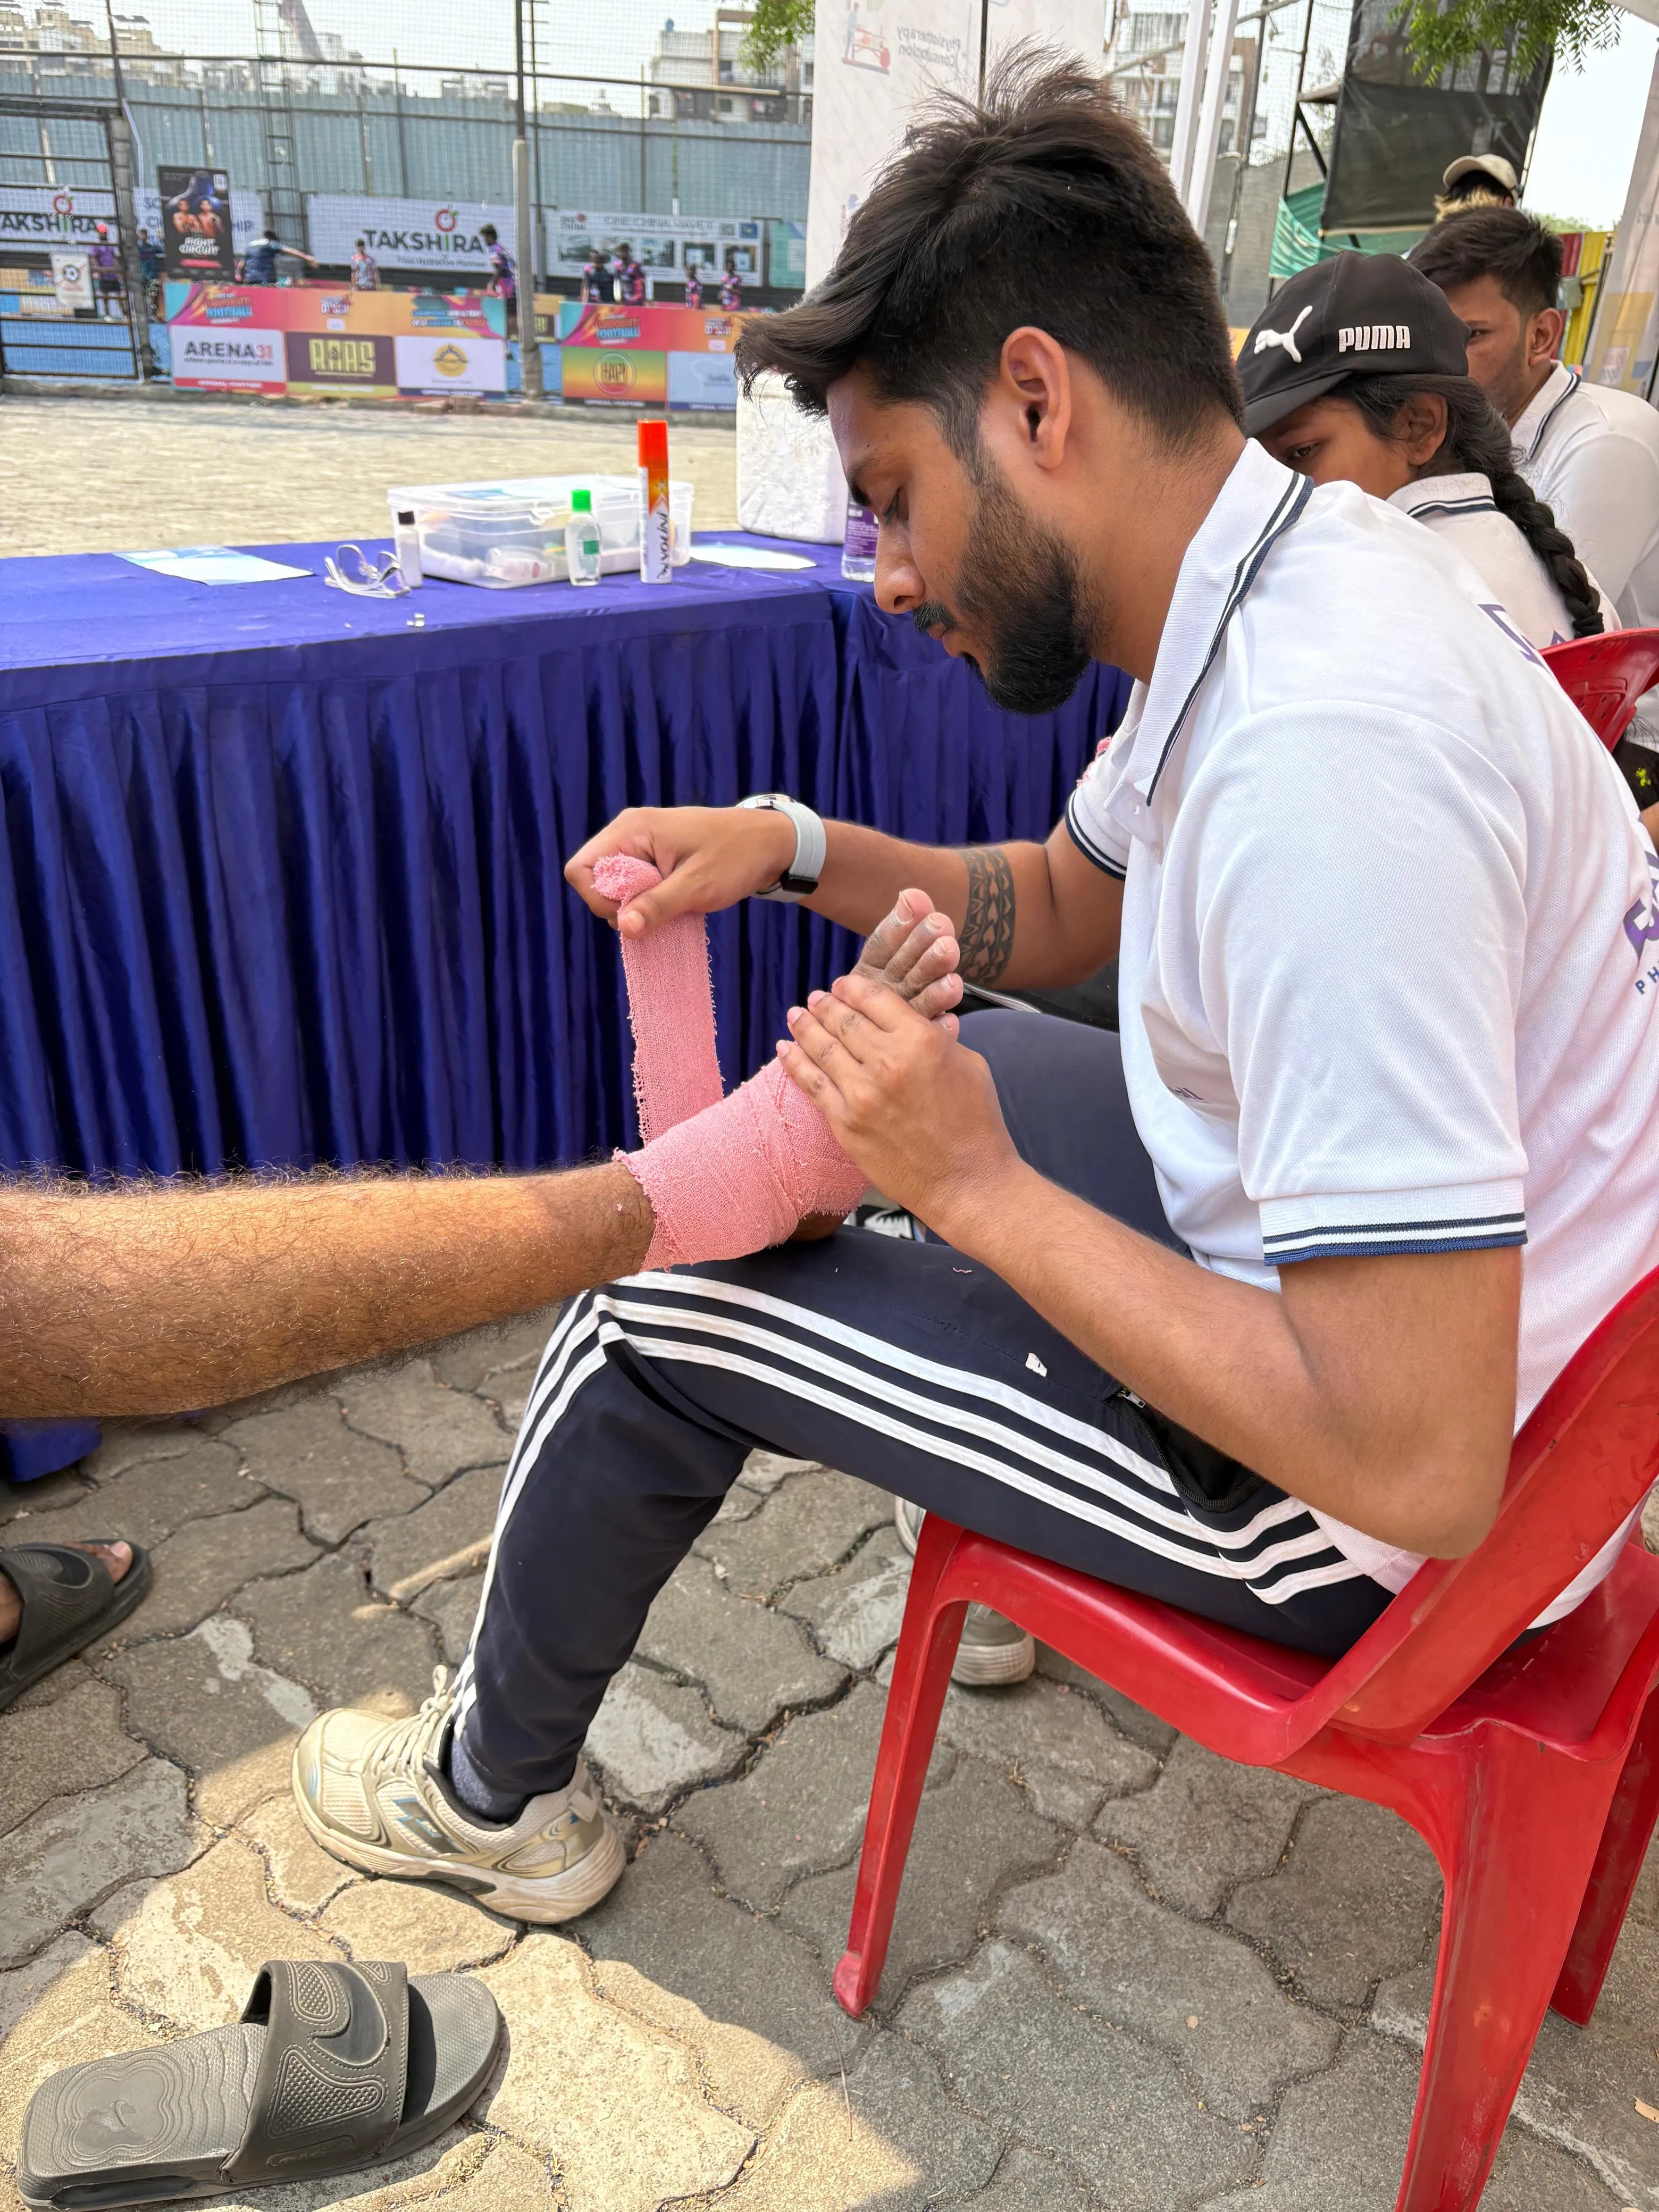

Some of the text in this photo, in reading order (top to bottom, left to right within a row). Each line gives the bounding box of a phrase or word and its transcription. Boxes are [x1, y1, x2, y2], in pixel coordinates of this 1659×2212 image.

[1, 213, 97, 233] AKSHIRA
[362, 229, 486, 253] TAKSHIRA
[1338, 325, 1410, 353] PUMA
[308, 339, 376, 372] RAAS
[656, 511, 668, 562] VOLINI
